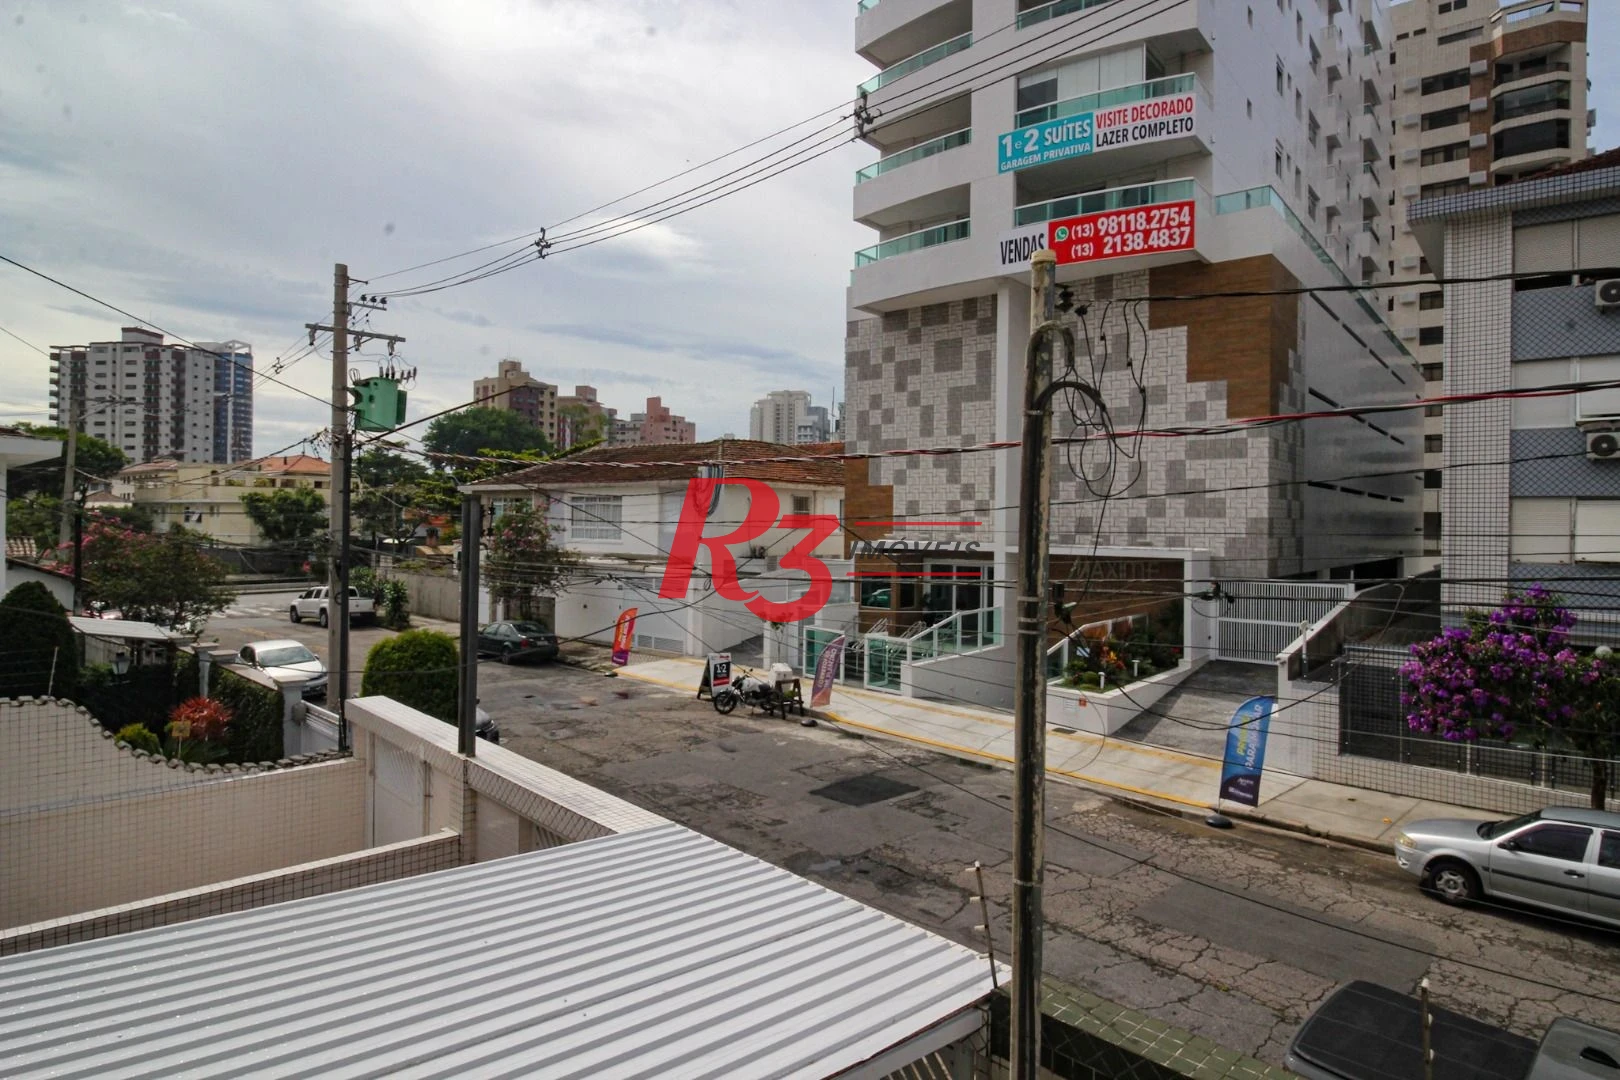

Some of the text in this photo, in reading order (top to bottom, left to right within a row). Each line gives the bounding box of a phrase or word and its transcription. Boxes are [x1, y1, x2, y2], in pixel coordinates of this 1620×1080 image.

[1096, 97, 1193, 129] VISITE DECORADO
[1002, 120, 1091, 158] 1 e 2 SUÍTES
[1096, 117, 1194, 148] LAZER COMPLETO
[1000, 142, 1091, 171] GARAGEM PRIVATIVA
[1071, 206, 1191, 238] (13) 98118.2754
[1000, 233, 1045, 265] VENDAS
[1071, 227, 1191, 259] (13) 2138.4837
